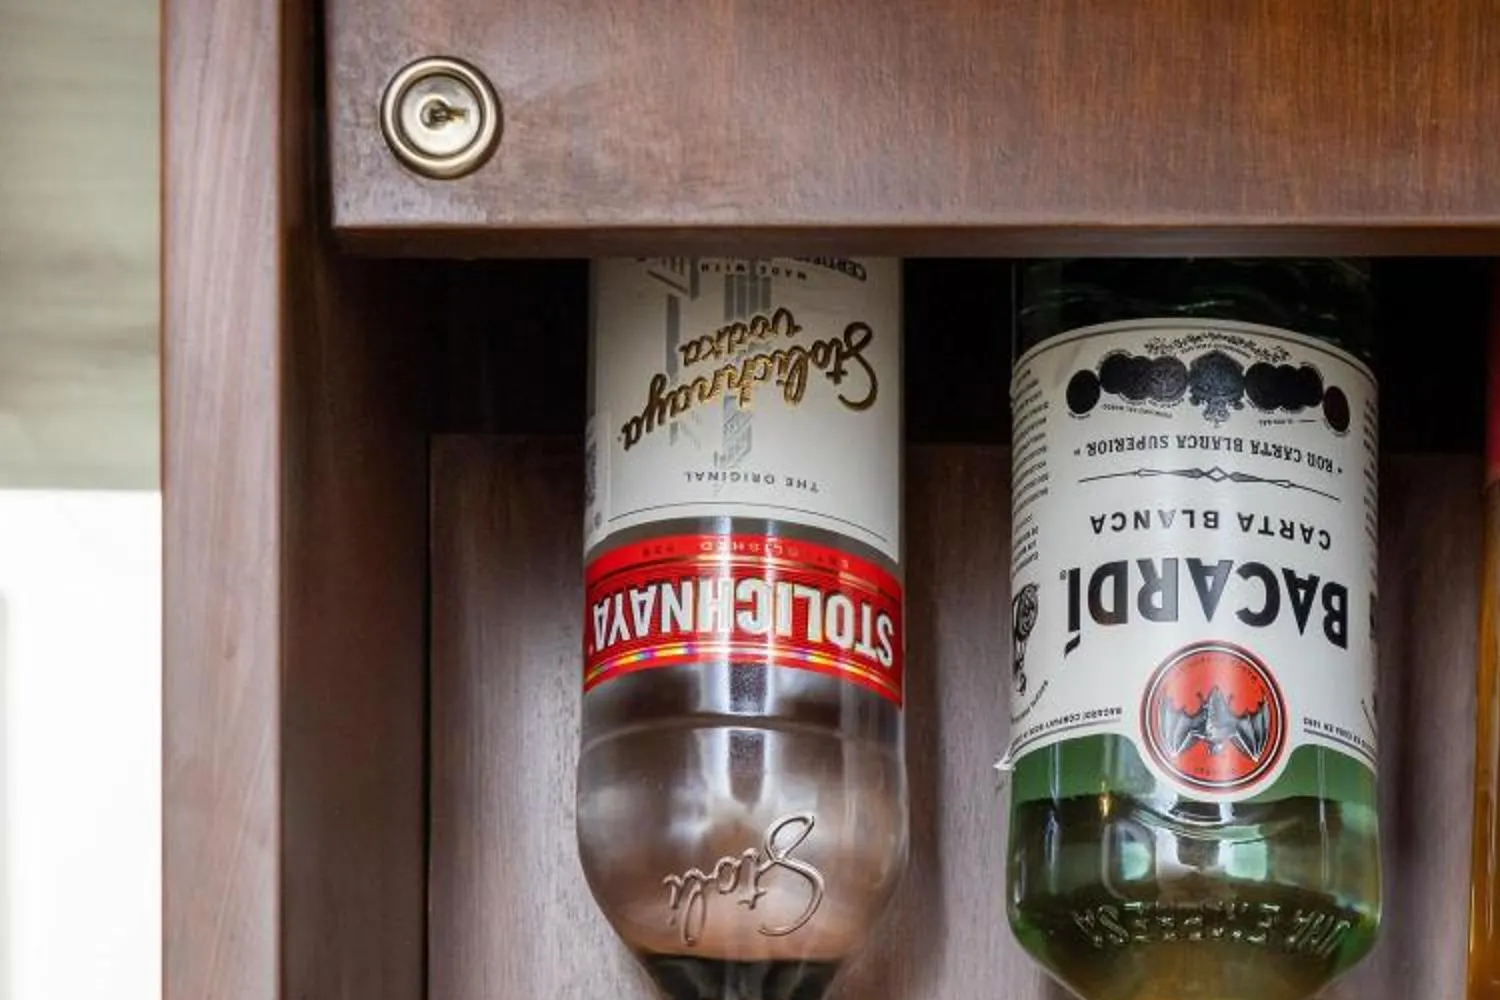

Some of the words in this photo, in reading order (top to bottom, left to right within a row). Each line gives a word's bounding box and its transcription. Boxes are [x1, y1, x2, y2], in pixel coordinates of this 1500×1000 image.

[699, 262, 745, 274] WITH
[679, 307, 802, 367] vodka
[621, 321, 878, 451] Stolichnaya
[1085, 434, 1168, 457] SUPERIOR
[1176, 434, 1243, 453] BLANCA
[1250, 440, 1302, 463] CARTA
[683, 470, 775, 486] ORIGINAL
[785, 476, 820, 494] THE
[1089, 508, 1220, 536] BLANCA
[1237, 511, 1331, 551] CARTA
[592, 576, 894, 668] STOLICHNAYA
[661, 815, 825, 948] Stoli
